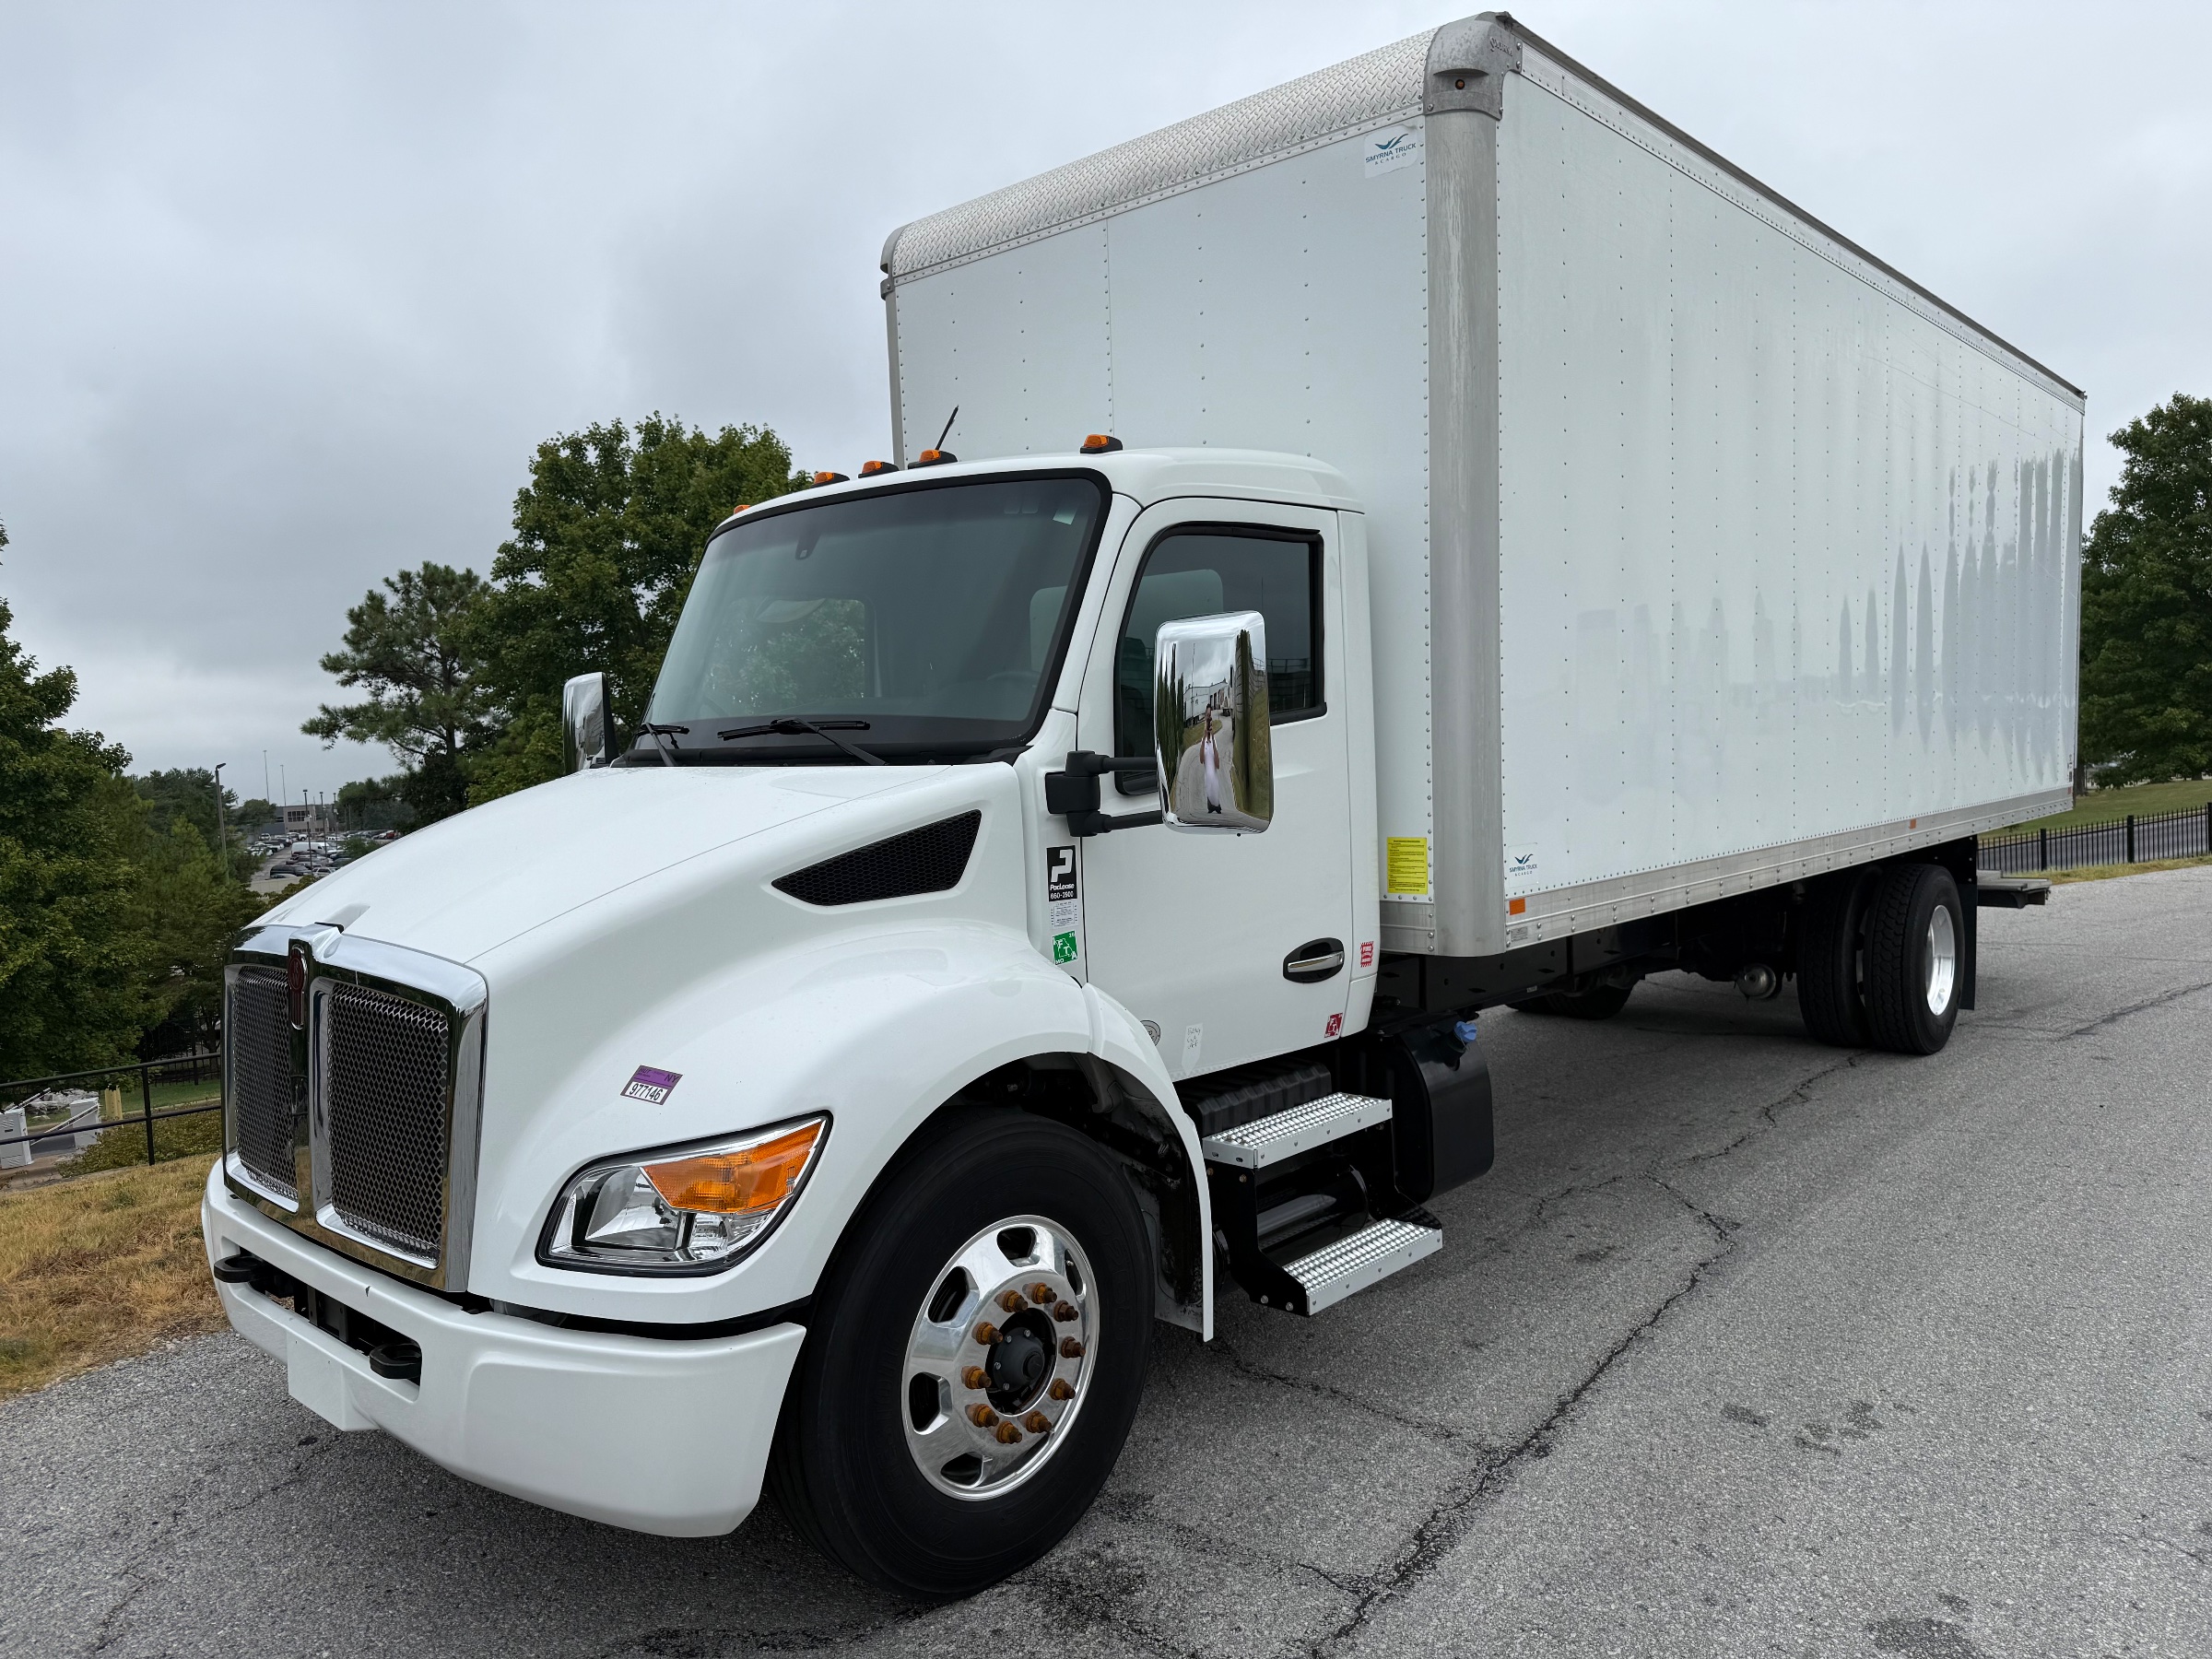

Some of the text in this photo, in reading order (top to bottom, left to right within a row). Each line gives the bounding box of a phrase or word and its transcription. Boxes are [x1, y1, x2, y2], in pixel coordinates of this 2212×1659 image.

[1365, 143, 1417, 163] SMYRNA TRUCK
[1380, 152, 1406, 163] CARGO
[1050, 883, 1075, 891] PacLease
[665, 1074, 680, 1083] NY
[629, 1083, 663, 1100] 977146
